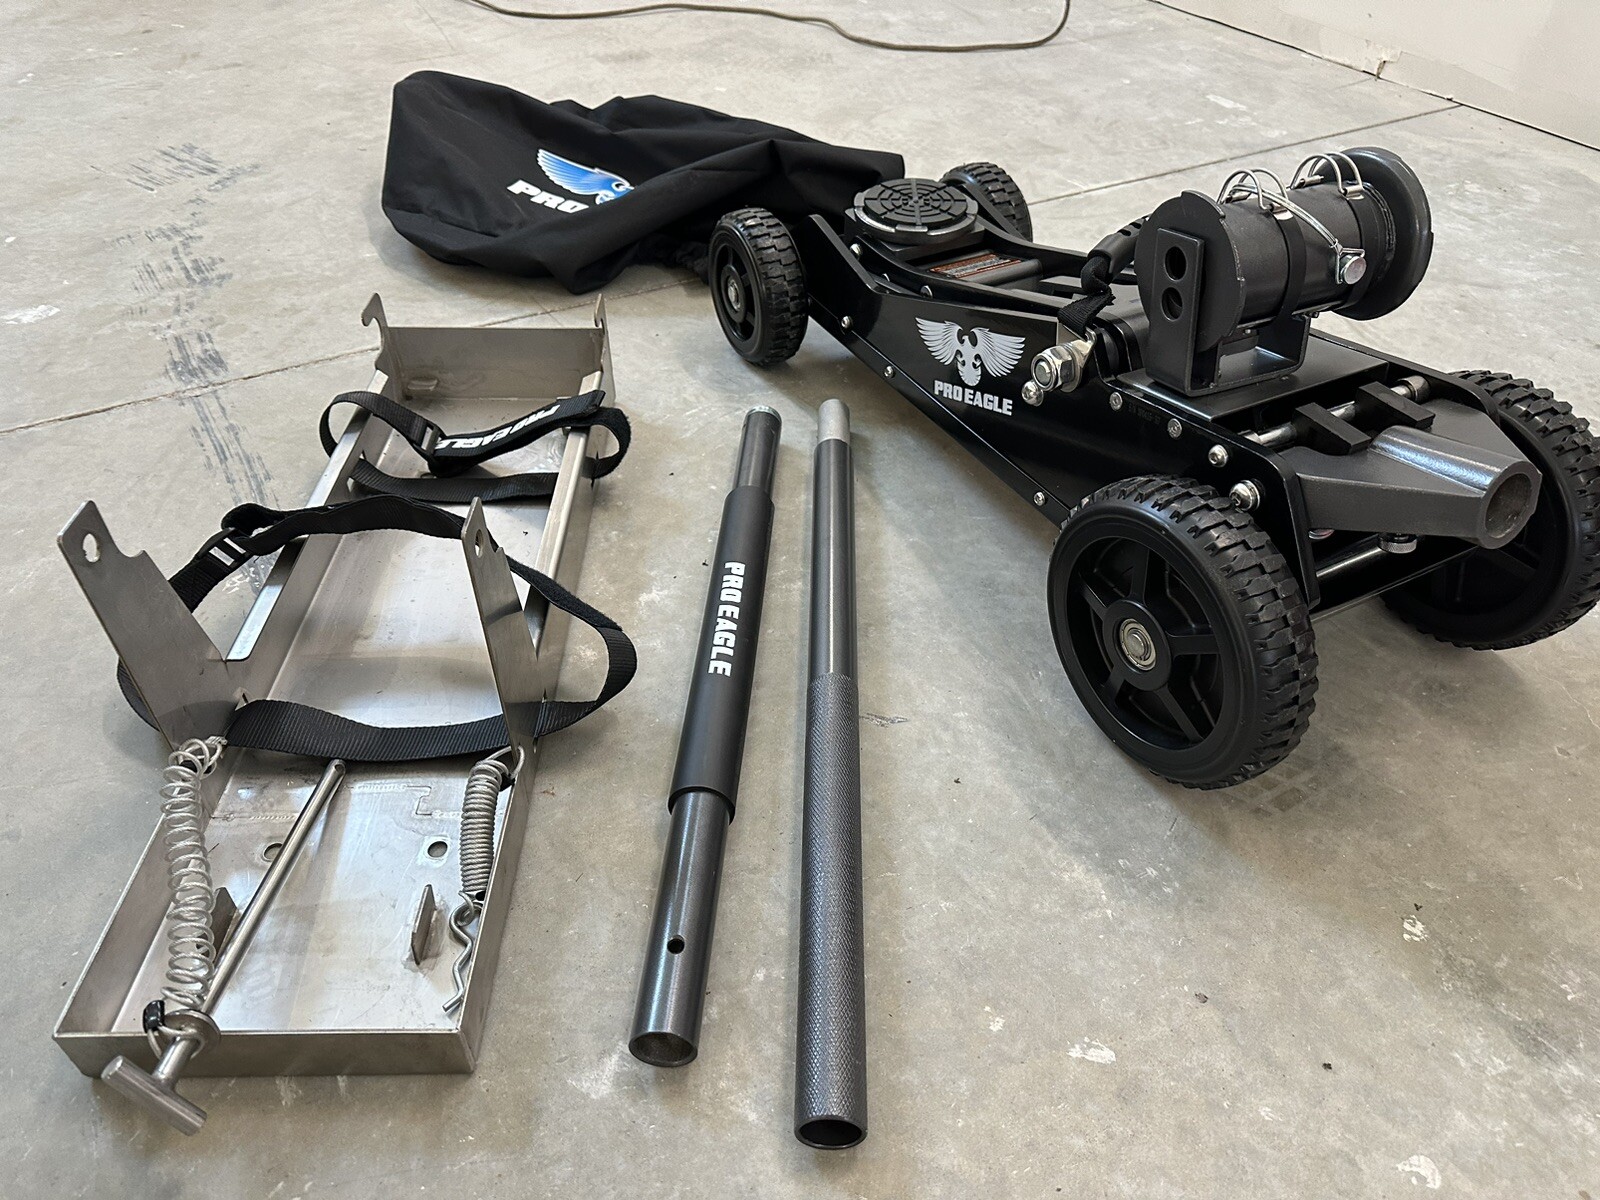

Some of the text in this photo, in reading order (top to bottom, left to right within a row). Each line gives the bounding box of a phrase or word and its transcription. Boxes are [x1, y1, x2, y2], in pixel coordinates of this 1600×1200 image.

[507, 179, 589, 213] PRO
[934, 380, 1013, 416] PRO EAGLE
[435, 404, 560, 450] PRO EAGLE
[707, 561, 746, 677] PRO EAGLE
